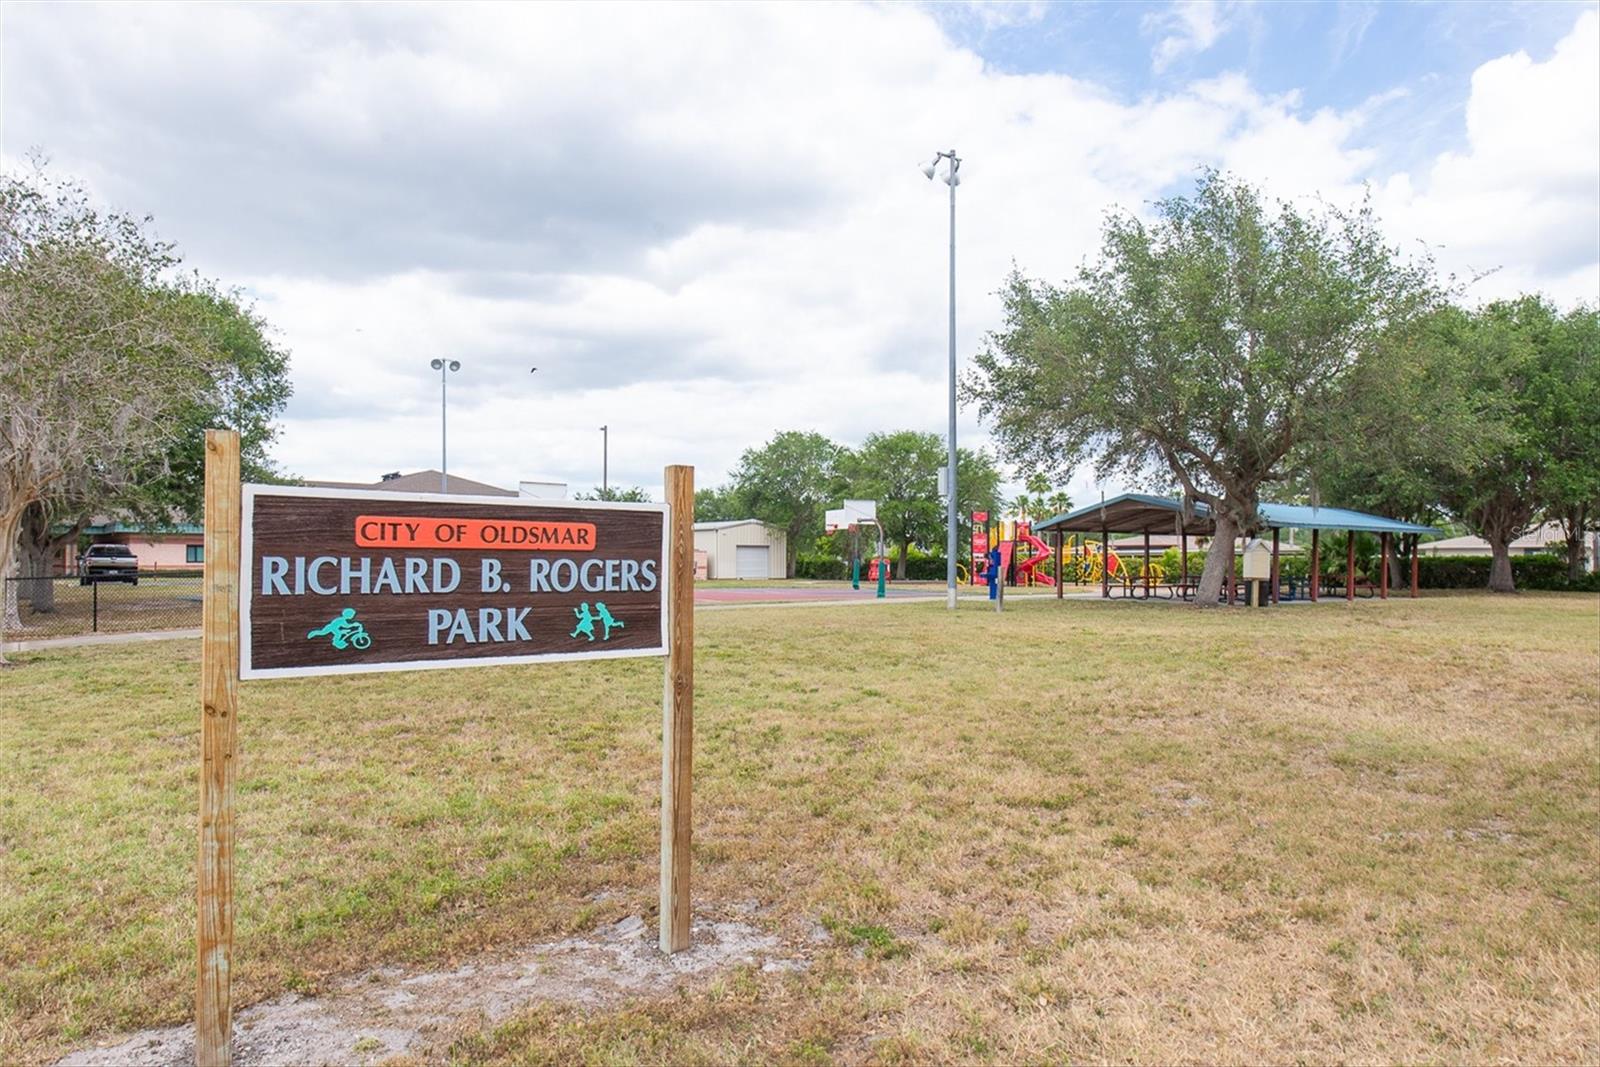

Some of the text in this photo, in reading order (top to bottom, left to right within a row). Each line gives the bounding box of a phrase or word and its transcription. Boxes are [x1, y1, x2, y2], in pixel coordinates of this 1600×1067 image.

[360, 521, 590, 545] CITY OF OLDSMAR
[261, 556, 657, 596] RICHARD B. ROGERS
[427, 606, 532, 646] PARK
